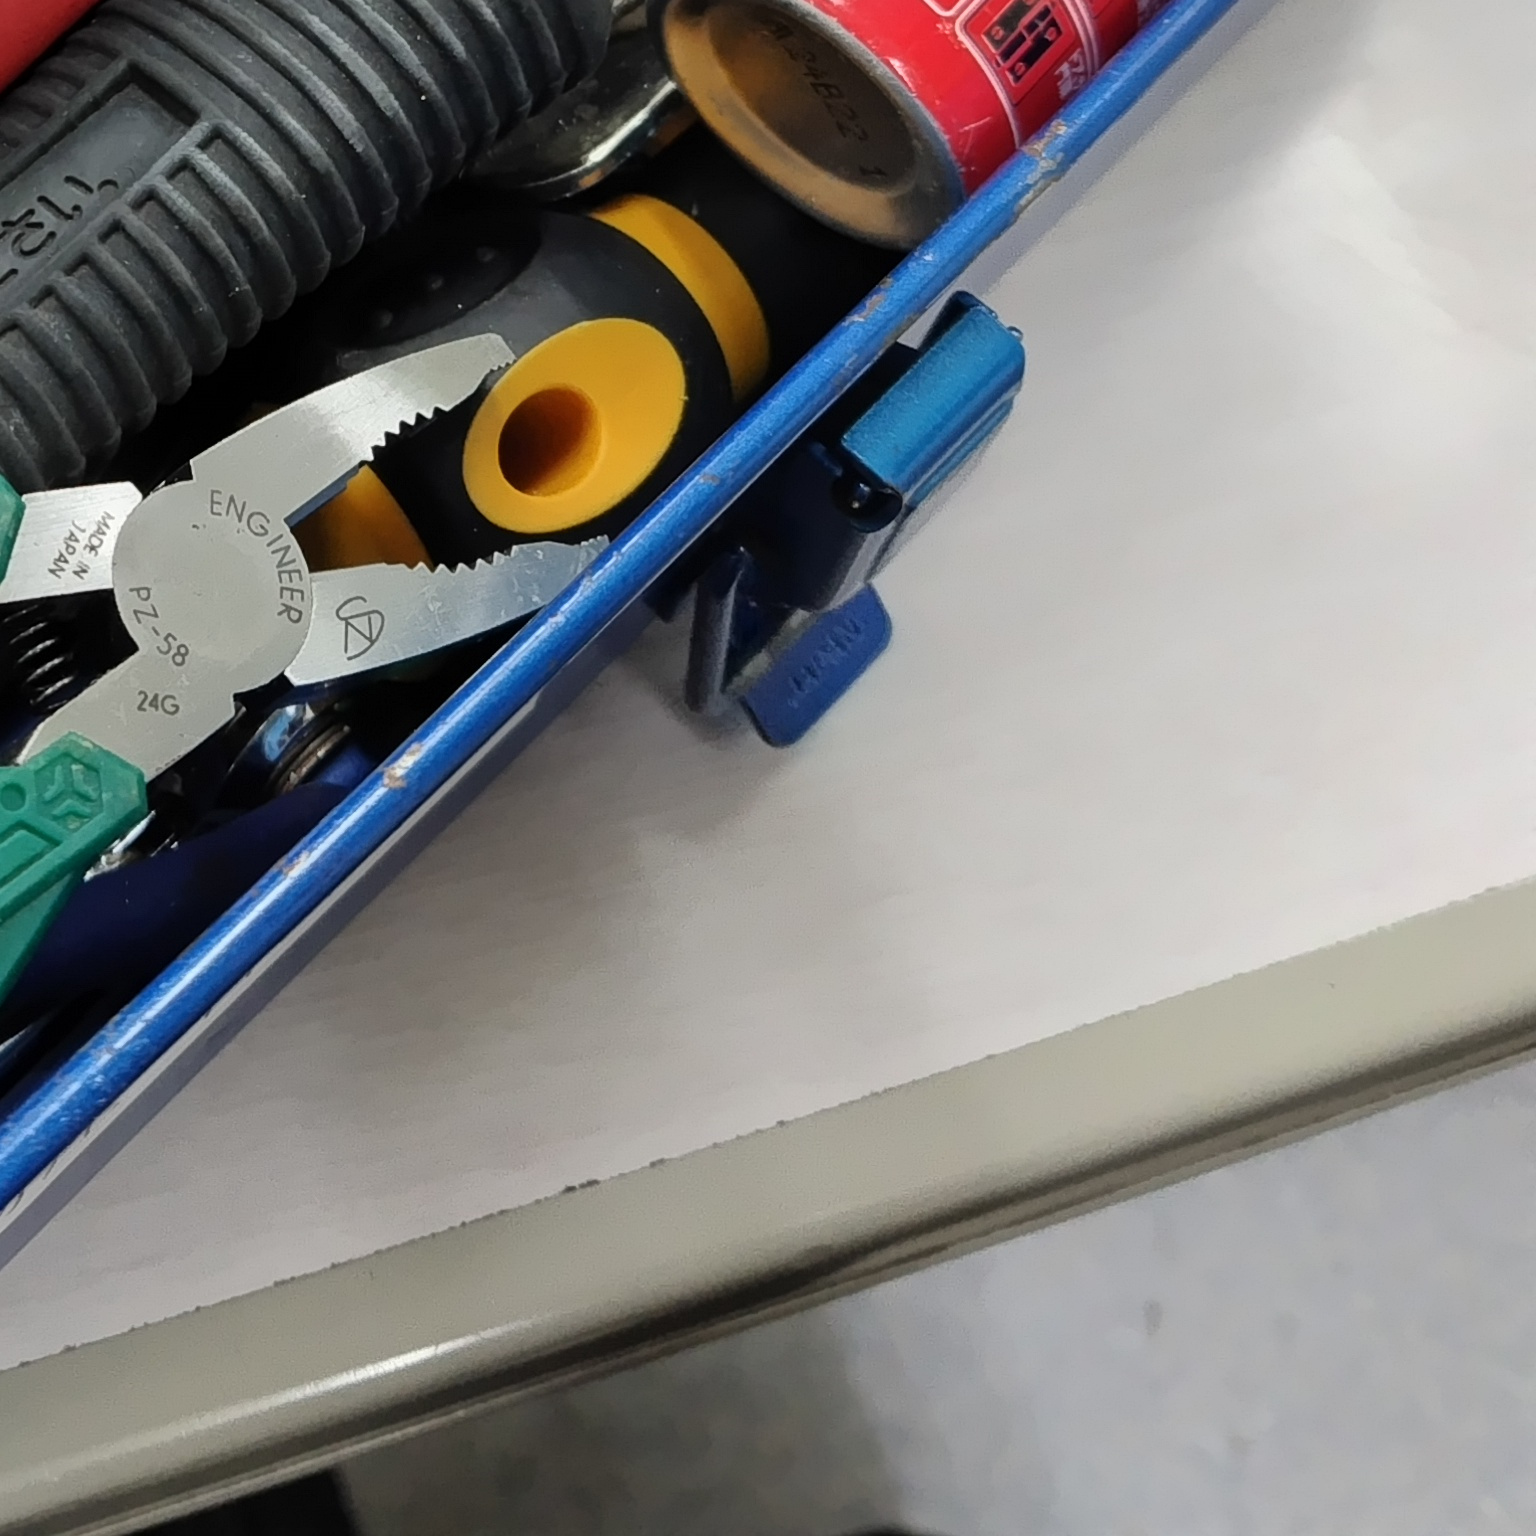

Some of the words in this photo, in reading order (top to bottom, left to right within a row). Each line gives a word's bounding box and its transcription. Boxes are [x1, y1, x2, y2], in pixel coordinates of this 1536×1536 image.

[46, 519, 87, 580] JAPAN
[83, 510, 116, 558] MADE
[209, 488, 306, 625] ENGINEER
[71, 559, 92, 581] IN
[128, 586, 190, 667] PZ-58
[136, 689, 181, 716] 24G
